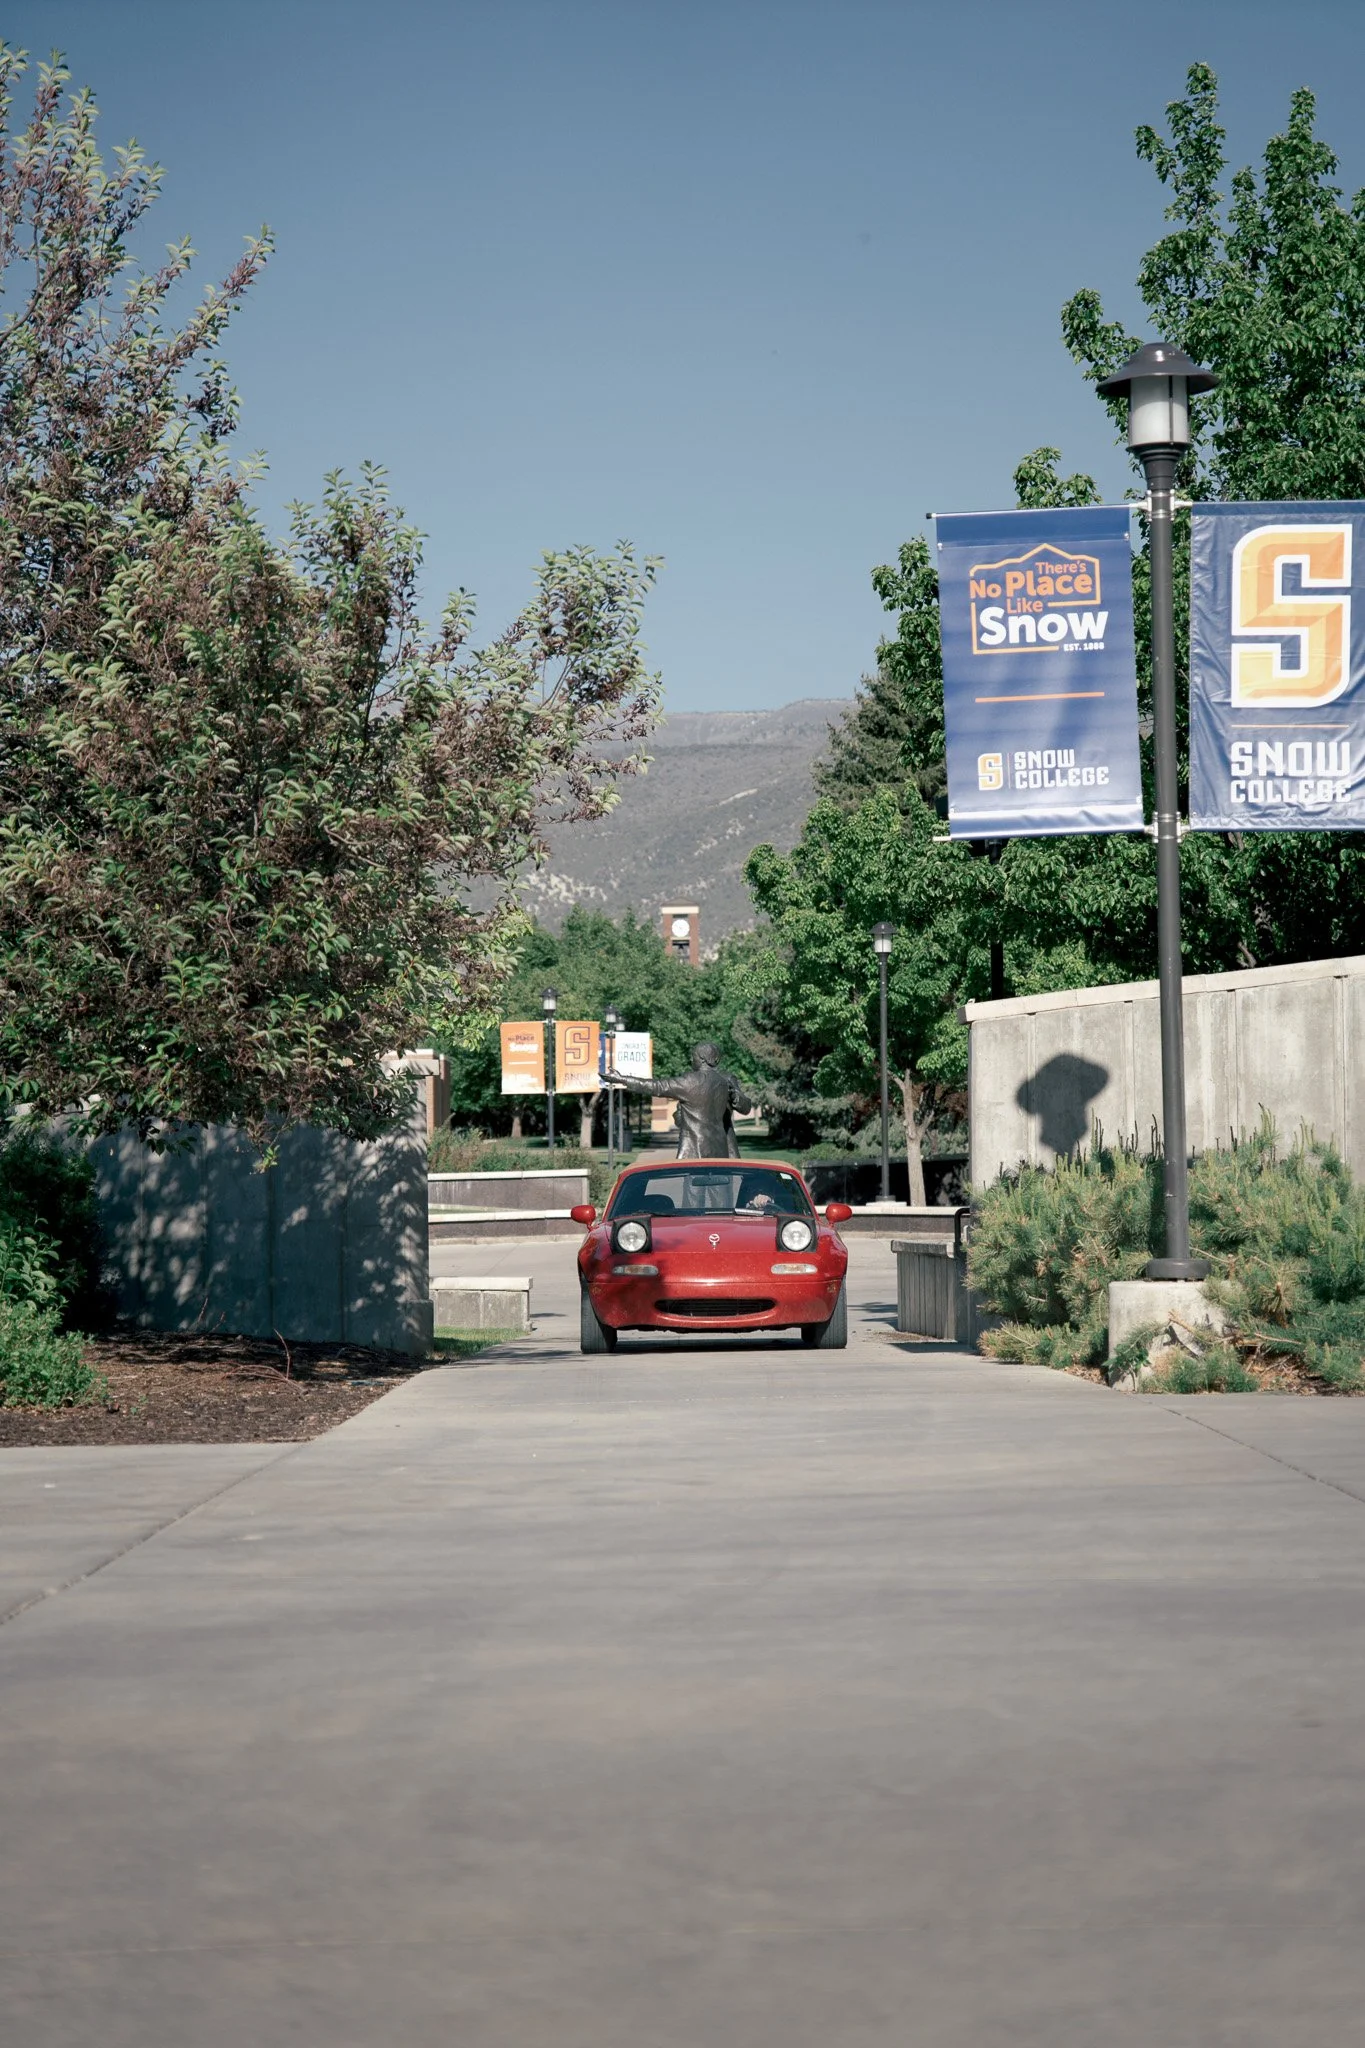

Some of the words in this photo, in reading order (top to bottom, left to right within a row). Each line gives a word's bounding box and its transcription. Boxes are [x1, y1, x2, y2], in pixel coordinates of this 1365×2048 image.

[1036, 560, 1086, 575] There's
[970, 579, 1001, 599] No
[1006, 571, 1092, 598] Place
[1006, 598, 1043, 614] Like
[1231, 524, 1352, 708] S
[979, 606, 1108, 646] Snow
[1063, 643, 1082, 652] EST.
[1014, 749, 1075, 770] SNOW
[1230, 740, 1351, 777] SNOW
[978, 752, 1003, 791] S
[1015, 766, 1110, 790] COLLEGE
[1230, 779, 1351, 804] COLLEGE
[564, 1026, 590, 1066] S
[617, 1051, 647, 1062] GRADS
